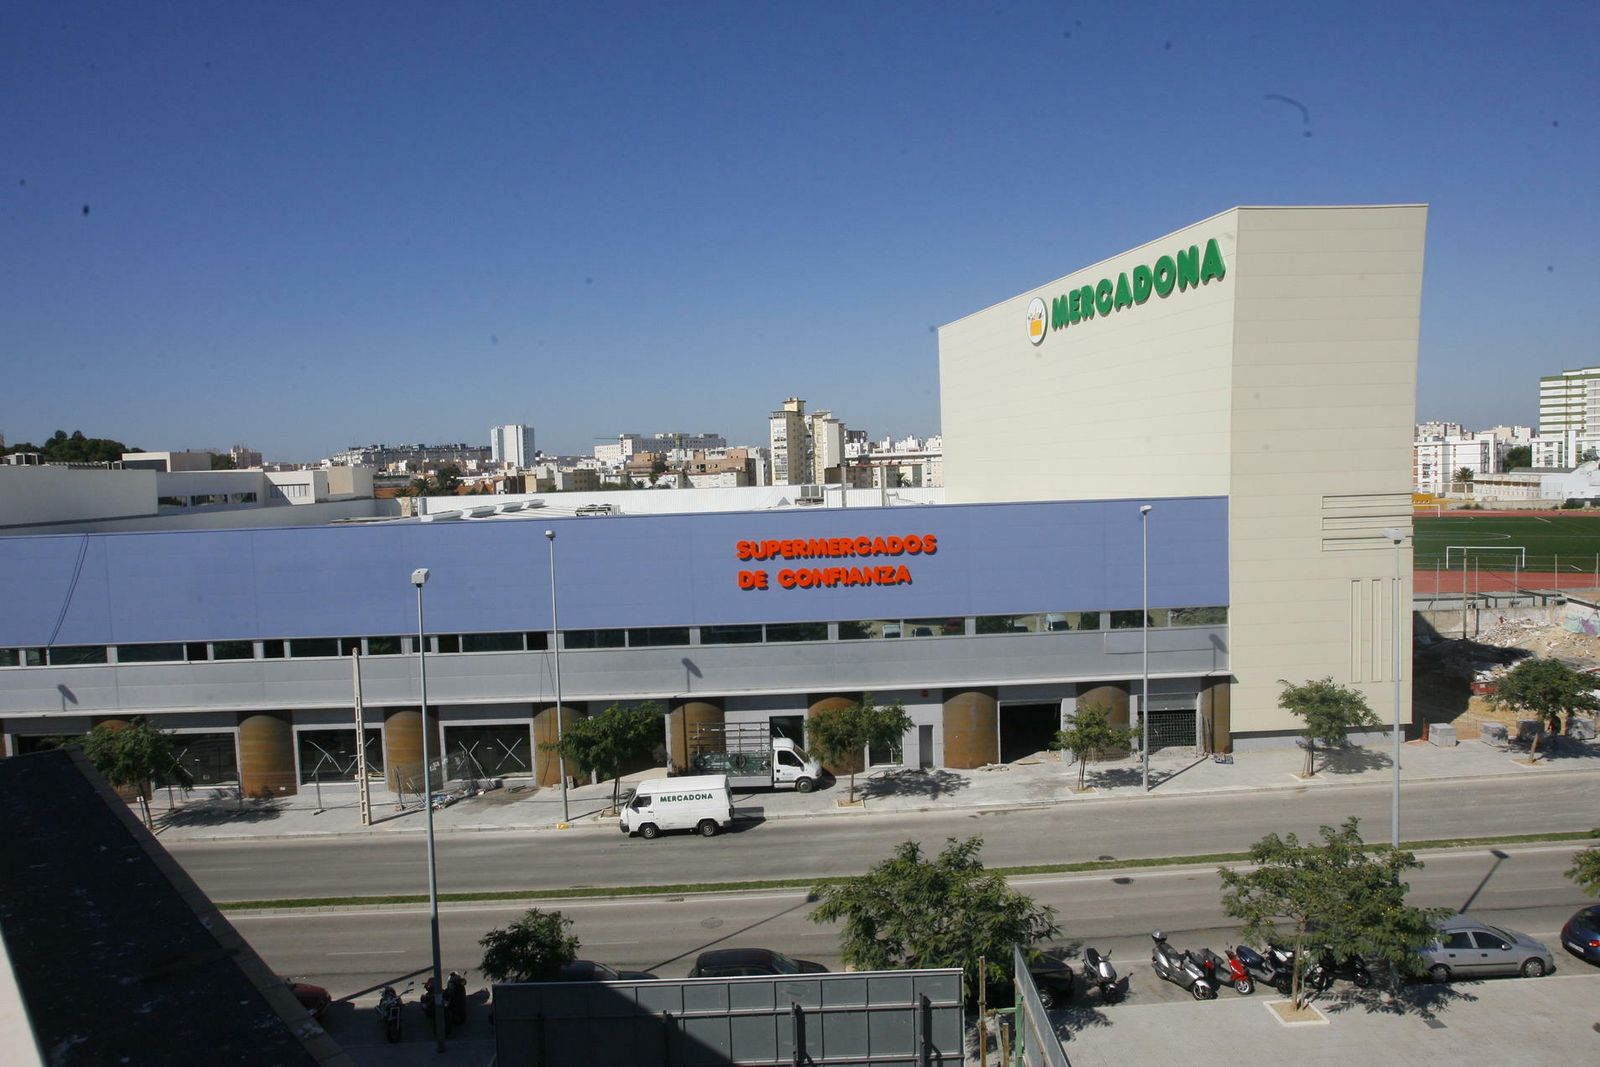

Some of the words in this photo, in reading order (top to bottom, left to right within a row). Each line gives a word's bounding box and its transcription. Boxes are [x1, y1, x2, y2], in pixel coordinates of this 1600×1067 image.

[1051, 237, 1226, 331] MERCADONA
[736, 534, 937, 561] SUPERMERCADOS
[738, 570, 768, 590] DE
[777, 565, 912, 589] CONFIANZA
[660, 793, 713, 802] MERCADONA
